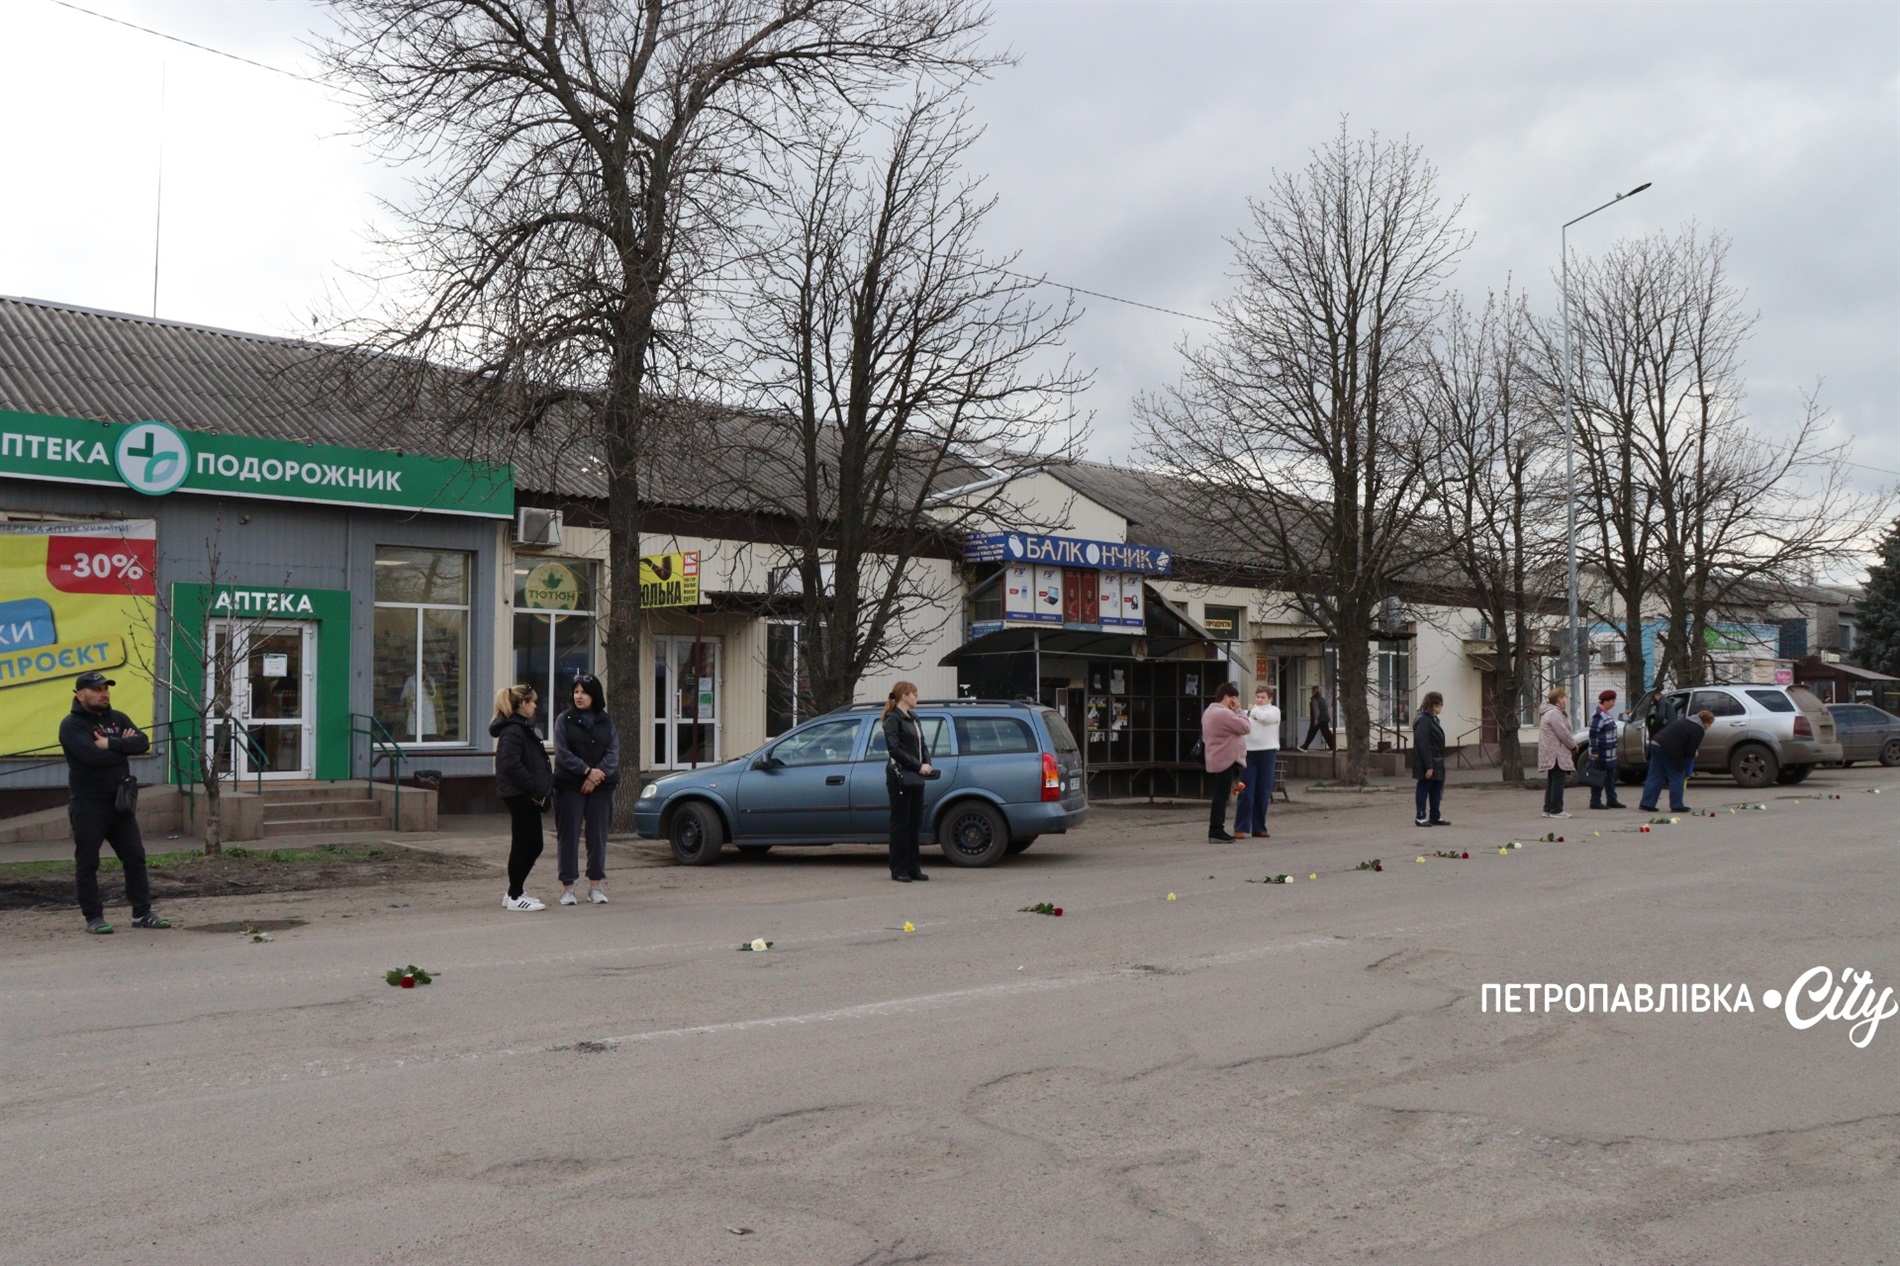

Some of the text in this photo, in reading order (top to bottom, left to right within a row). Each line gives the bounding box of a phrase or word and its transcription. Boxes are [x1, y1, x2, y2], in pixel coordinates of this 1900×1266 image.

[2, 432, 402, 492] ПТЕКА ПОДОРОЖНИК
[47, 525, 81, 534] АПТЕК
[215, 590, 313, 613] АПТЕКА
[528, 589, 575, 601] ТЮТЮН
[640, 581, 681, 606] ЮЛЬКА
[0, 642, 109, 680] ПРОЄКТ
